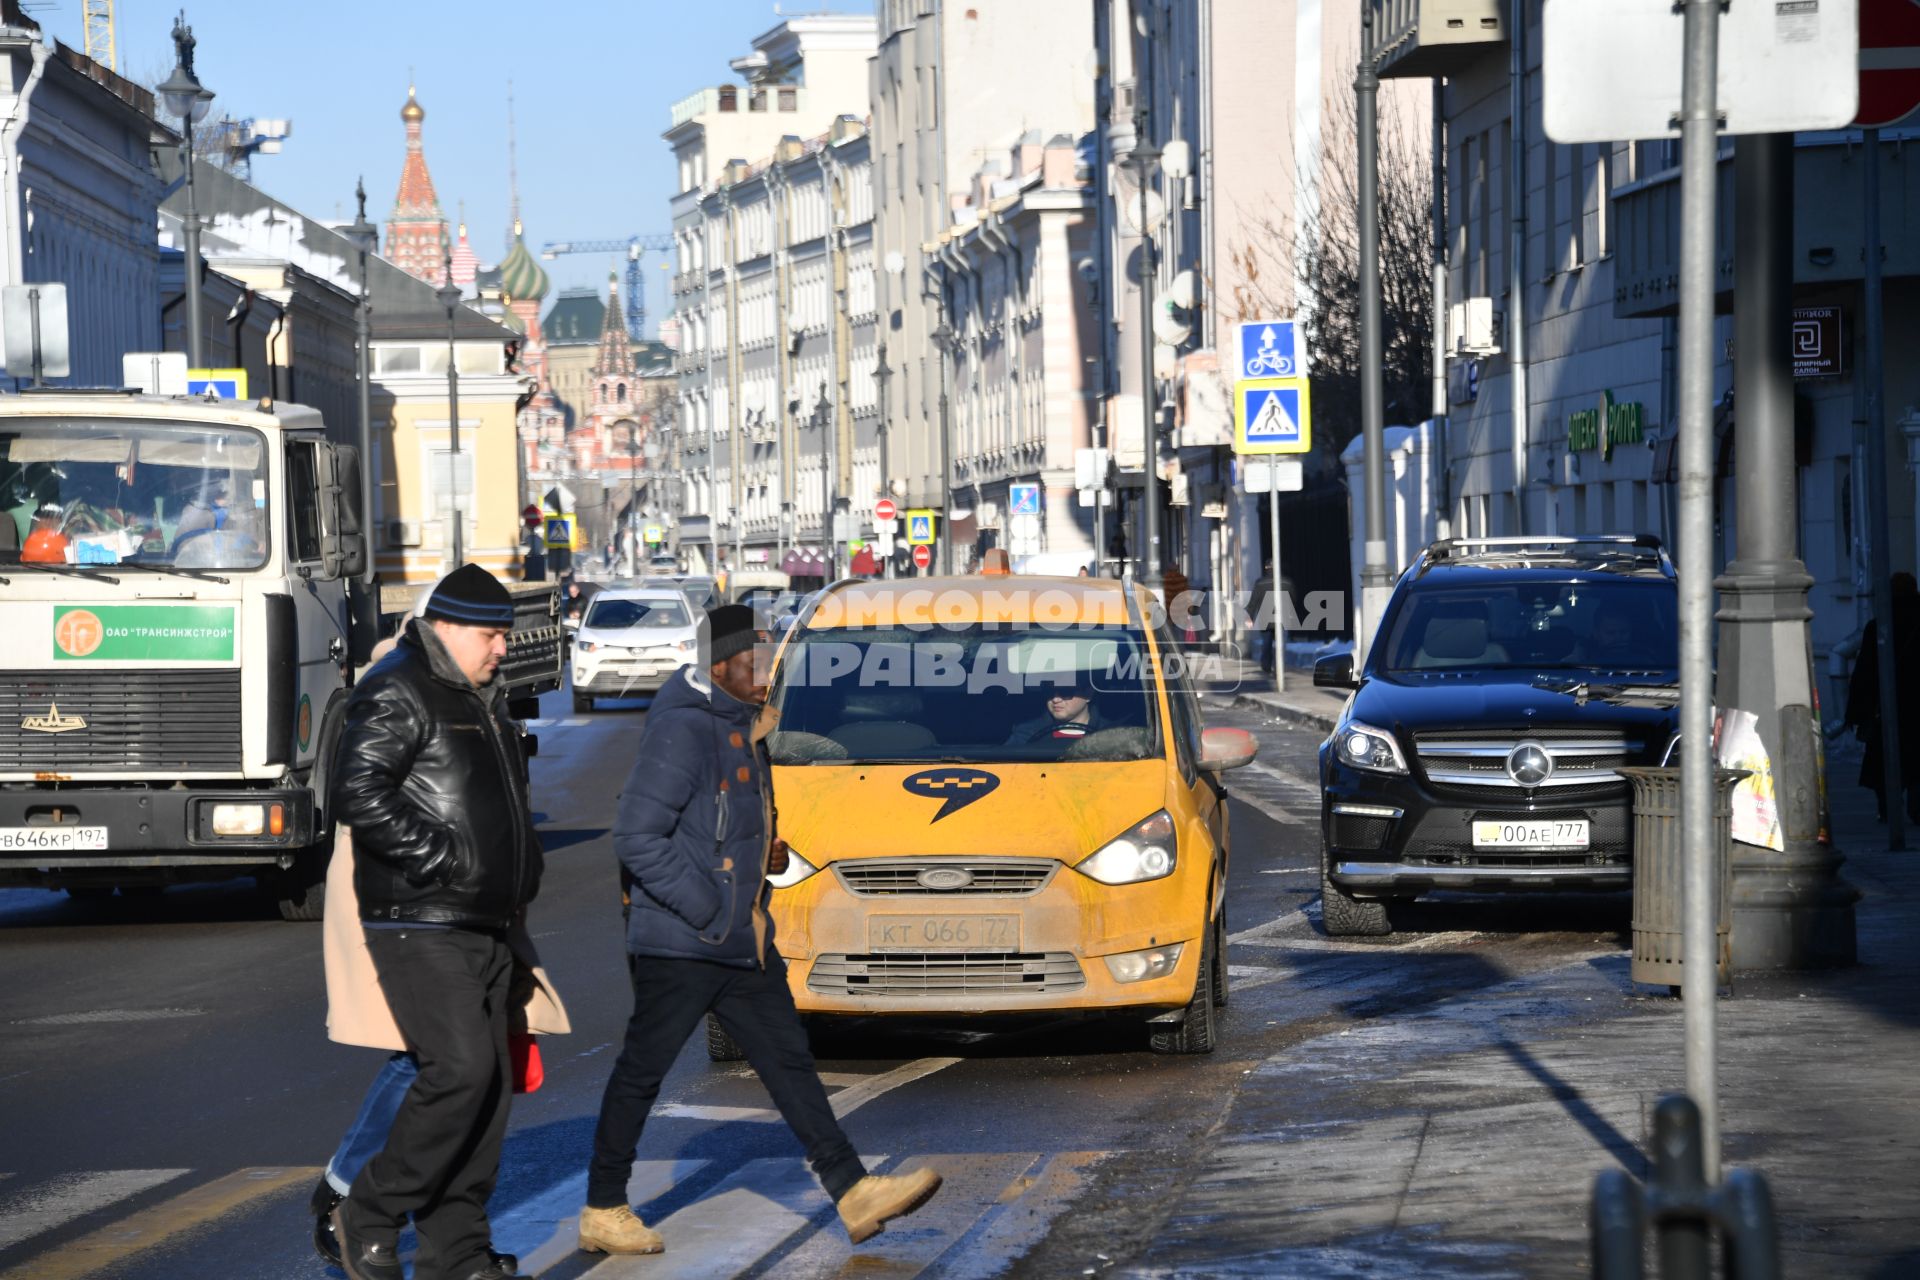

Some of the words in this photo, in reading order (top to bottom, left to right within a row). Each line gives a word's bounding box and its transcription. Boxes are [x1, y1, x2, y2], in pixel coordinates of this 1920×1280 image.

[1567, 409, 1598, 451] АПТЕКА
[106, 628, 128, 637] ОАО
[130, 627, 233, 638] "ТРАНСИНЖСТРОЙ"
[76, 829, 101, 842] 197
[1480, 825, 1551, 842] 00АЕ
[1555, 823, 1583, 837] 777
[882, 925, 912, 943] КТ
[923, 919, 970, 942] 066
[985, 918, 1009, 941] 77
